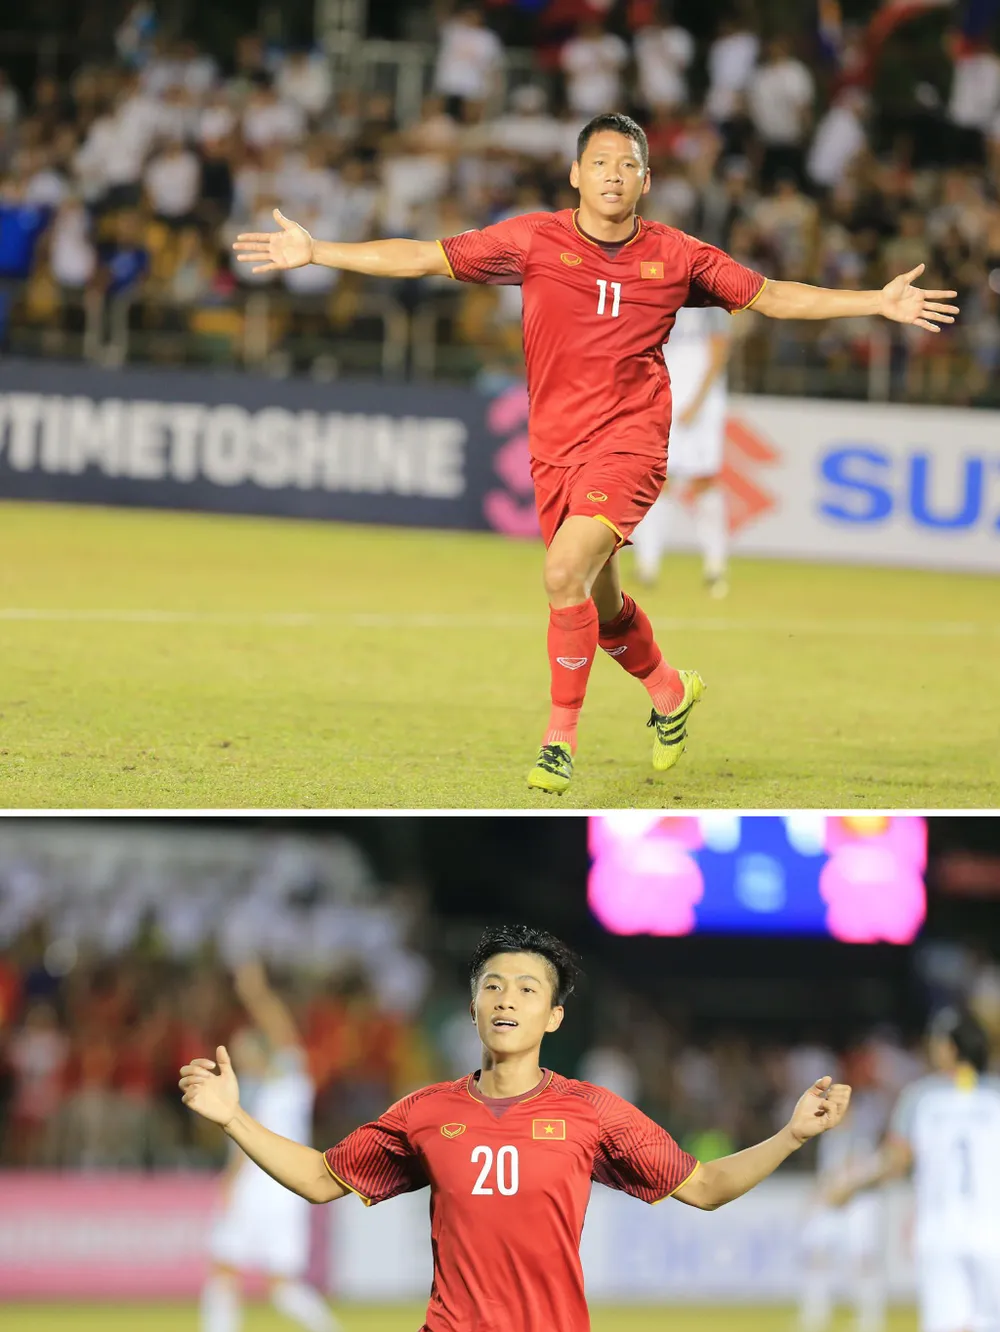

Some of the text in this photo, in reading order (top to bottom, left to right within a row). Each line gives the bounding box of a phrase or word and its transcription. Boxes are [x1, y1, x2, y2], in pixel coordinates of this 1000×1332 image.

[596, 279, 621, 317] 11
[819, 445, 1000, 530] SU
[471, 1145, 519, 1196] 20
